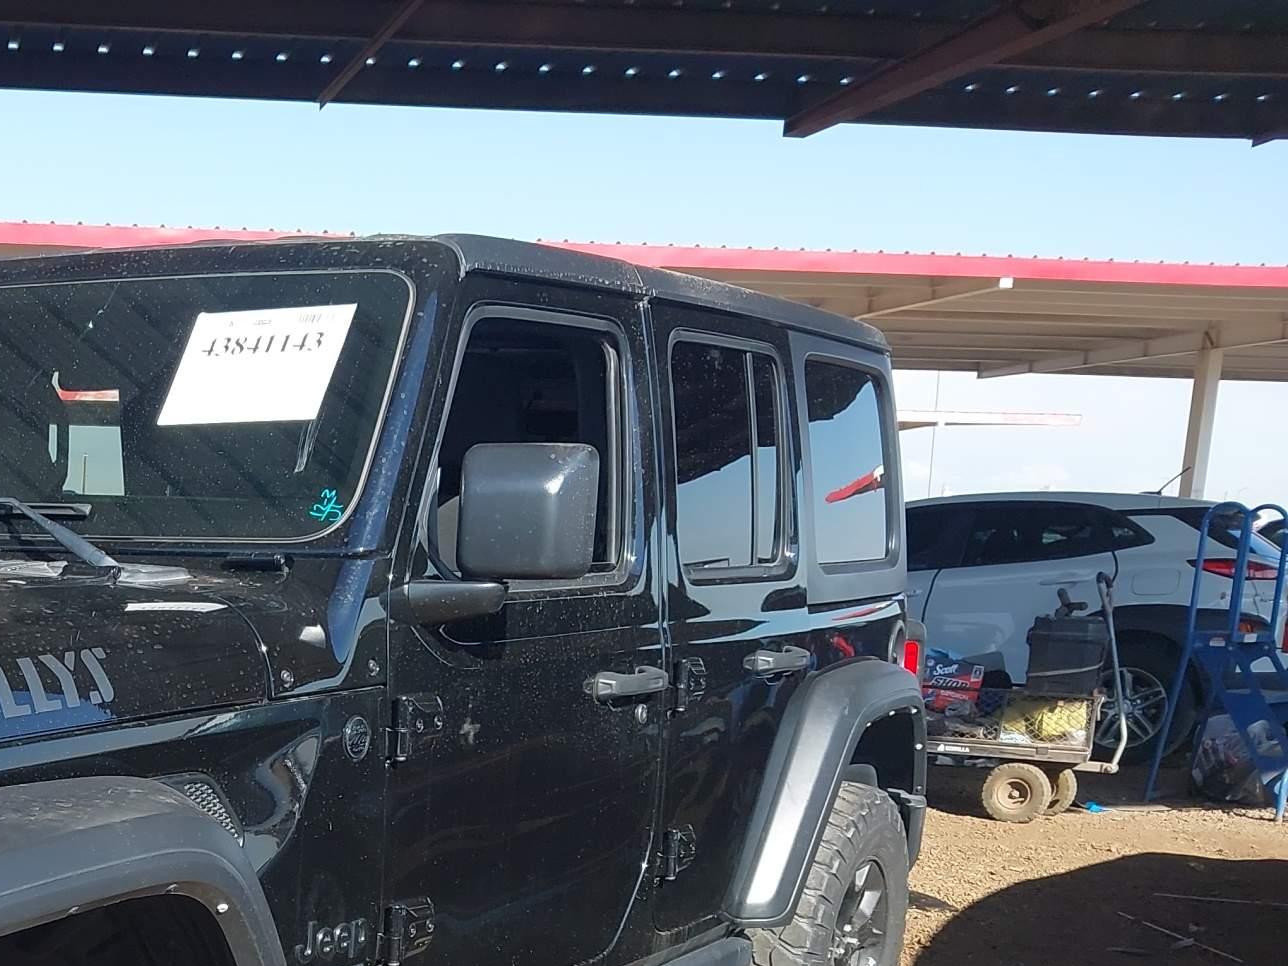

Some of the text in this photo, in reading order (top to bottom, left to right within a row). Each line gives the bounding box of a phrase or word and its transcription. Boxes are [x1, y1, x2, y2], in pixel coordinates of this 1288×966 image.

[202, 331, 325, 357] 43841143
[933, 664, 960, 676] Scott
[294, 918, 366, 965] Jeep
